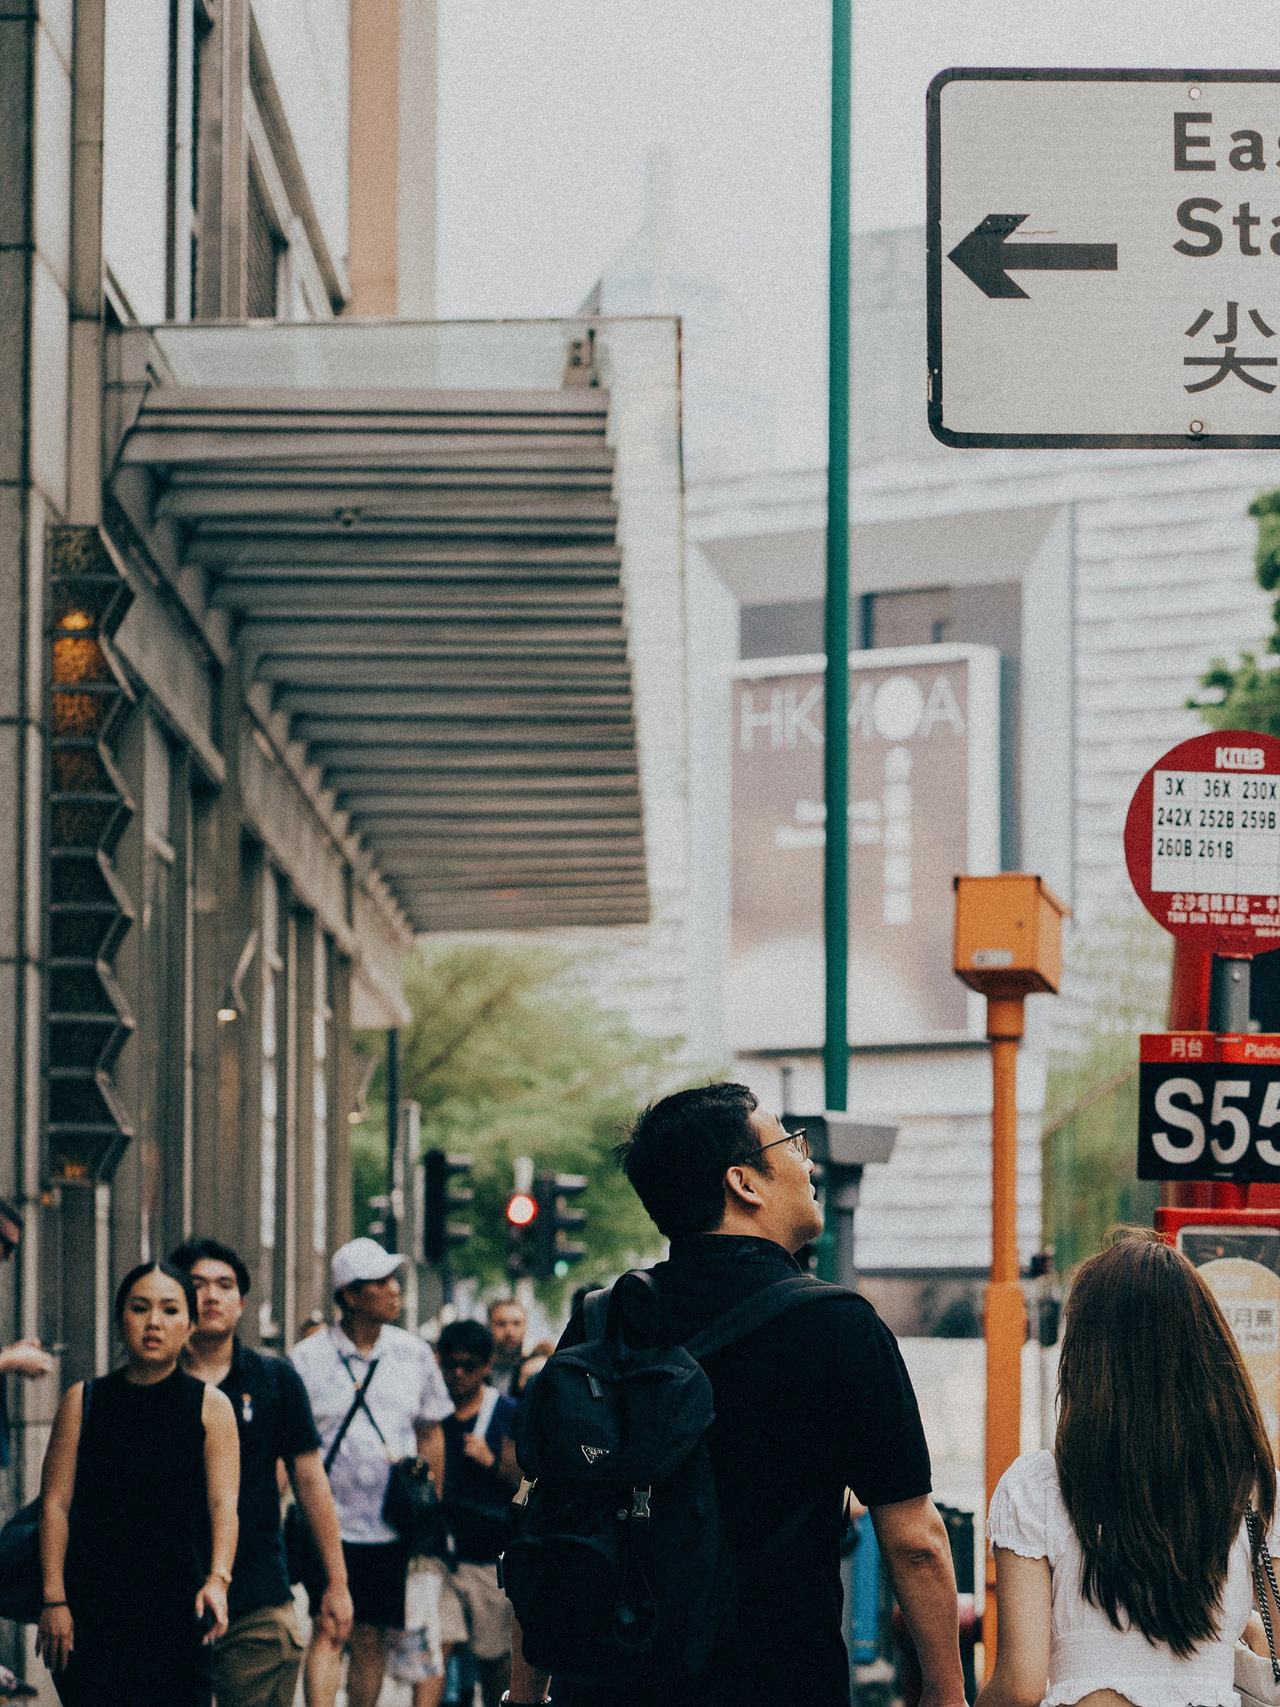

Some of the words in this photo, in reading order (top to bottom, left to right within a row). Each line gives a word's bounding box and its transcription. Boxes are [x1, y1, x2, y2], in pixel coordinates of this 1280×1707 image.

[1215, 746, 1266, 770] KMB
[1165, 777, 1185, 796] 3X
[1203, 778, 1231, 799] 36X
[1242, 780, 1277, 801] 230X
[1157, 807, 1192, 828] 242X
[1199, 809, 1235, 830] 252B
[1240, 810, 1277, 831] 259B
[1157, 837, 1193, 858] 260B
[1198, 839, 1234, 859] 261B
[1170, 1037, 1203, 1058] 月台
